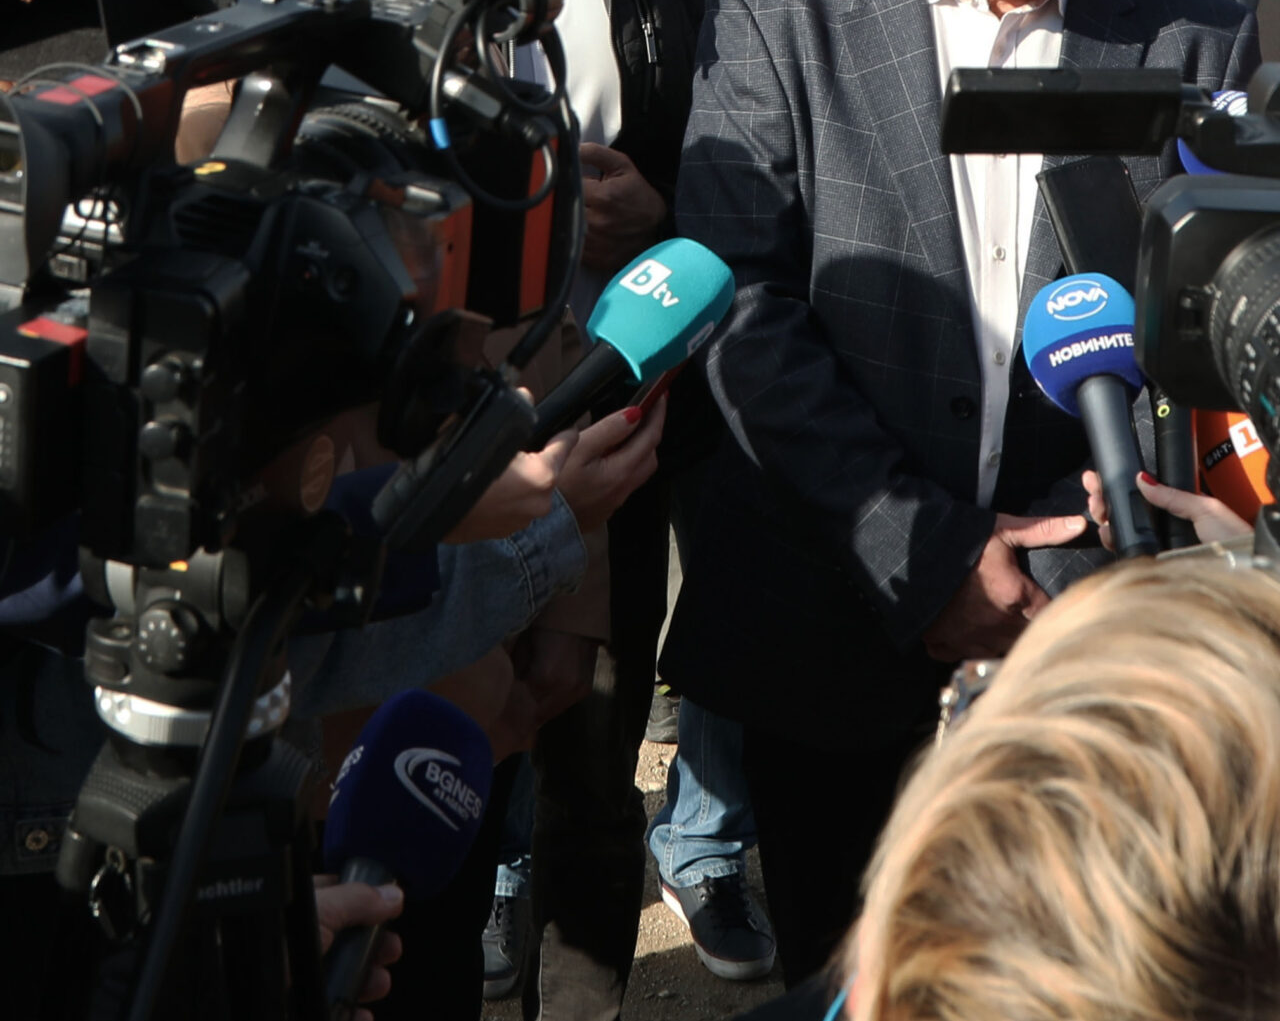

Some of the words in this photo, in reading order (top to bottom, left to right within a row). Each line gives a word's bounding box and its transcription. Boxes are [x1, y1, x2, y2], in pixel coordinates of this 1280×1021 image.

[1046, 287, 1109, 315] NOVA
[1048, 332, 1134, 367] НОВИНИТЕ
[1238, 426, 1258, 448] 1
[425, 761, 482, 819] BGNES
